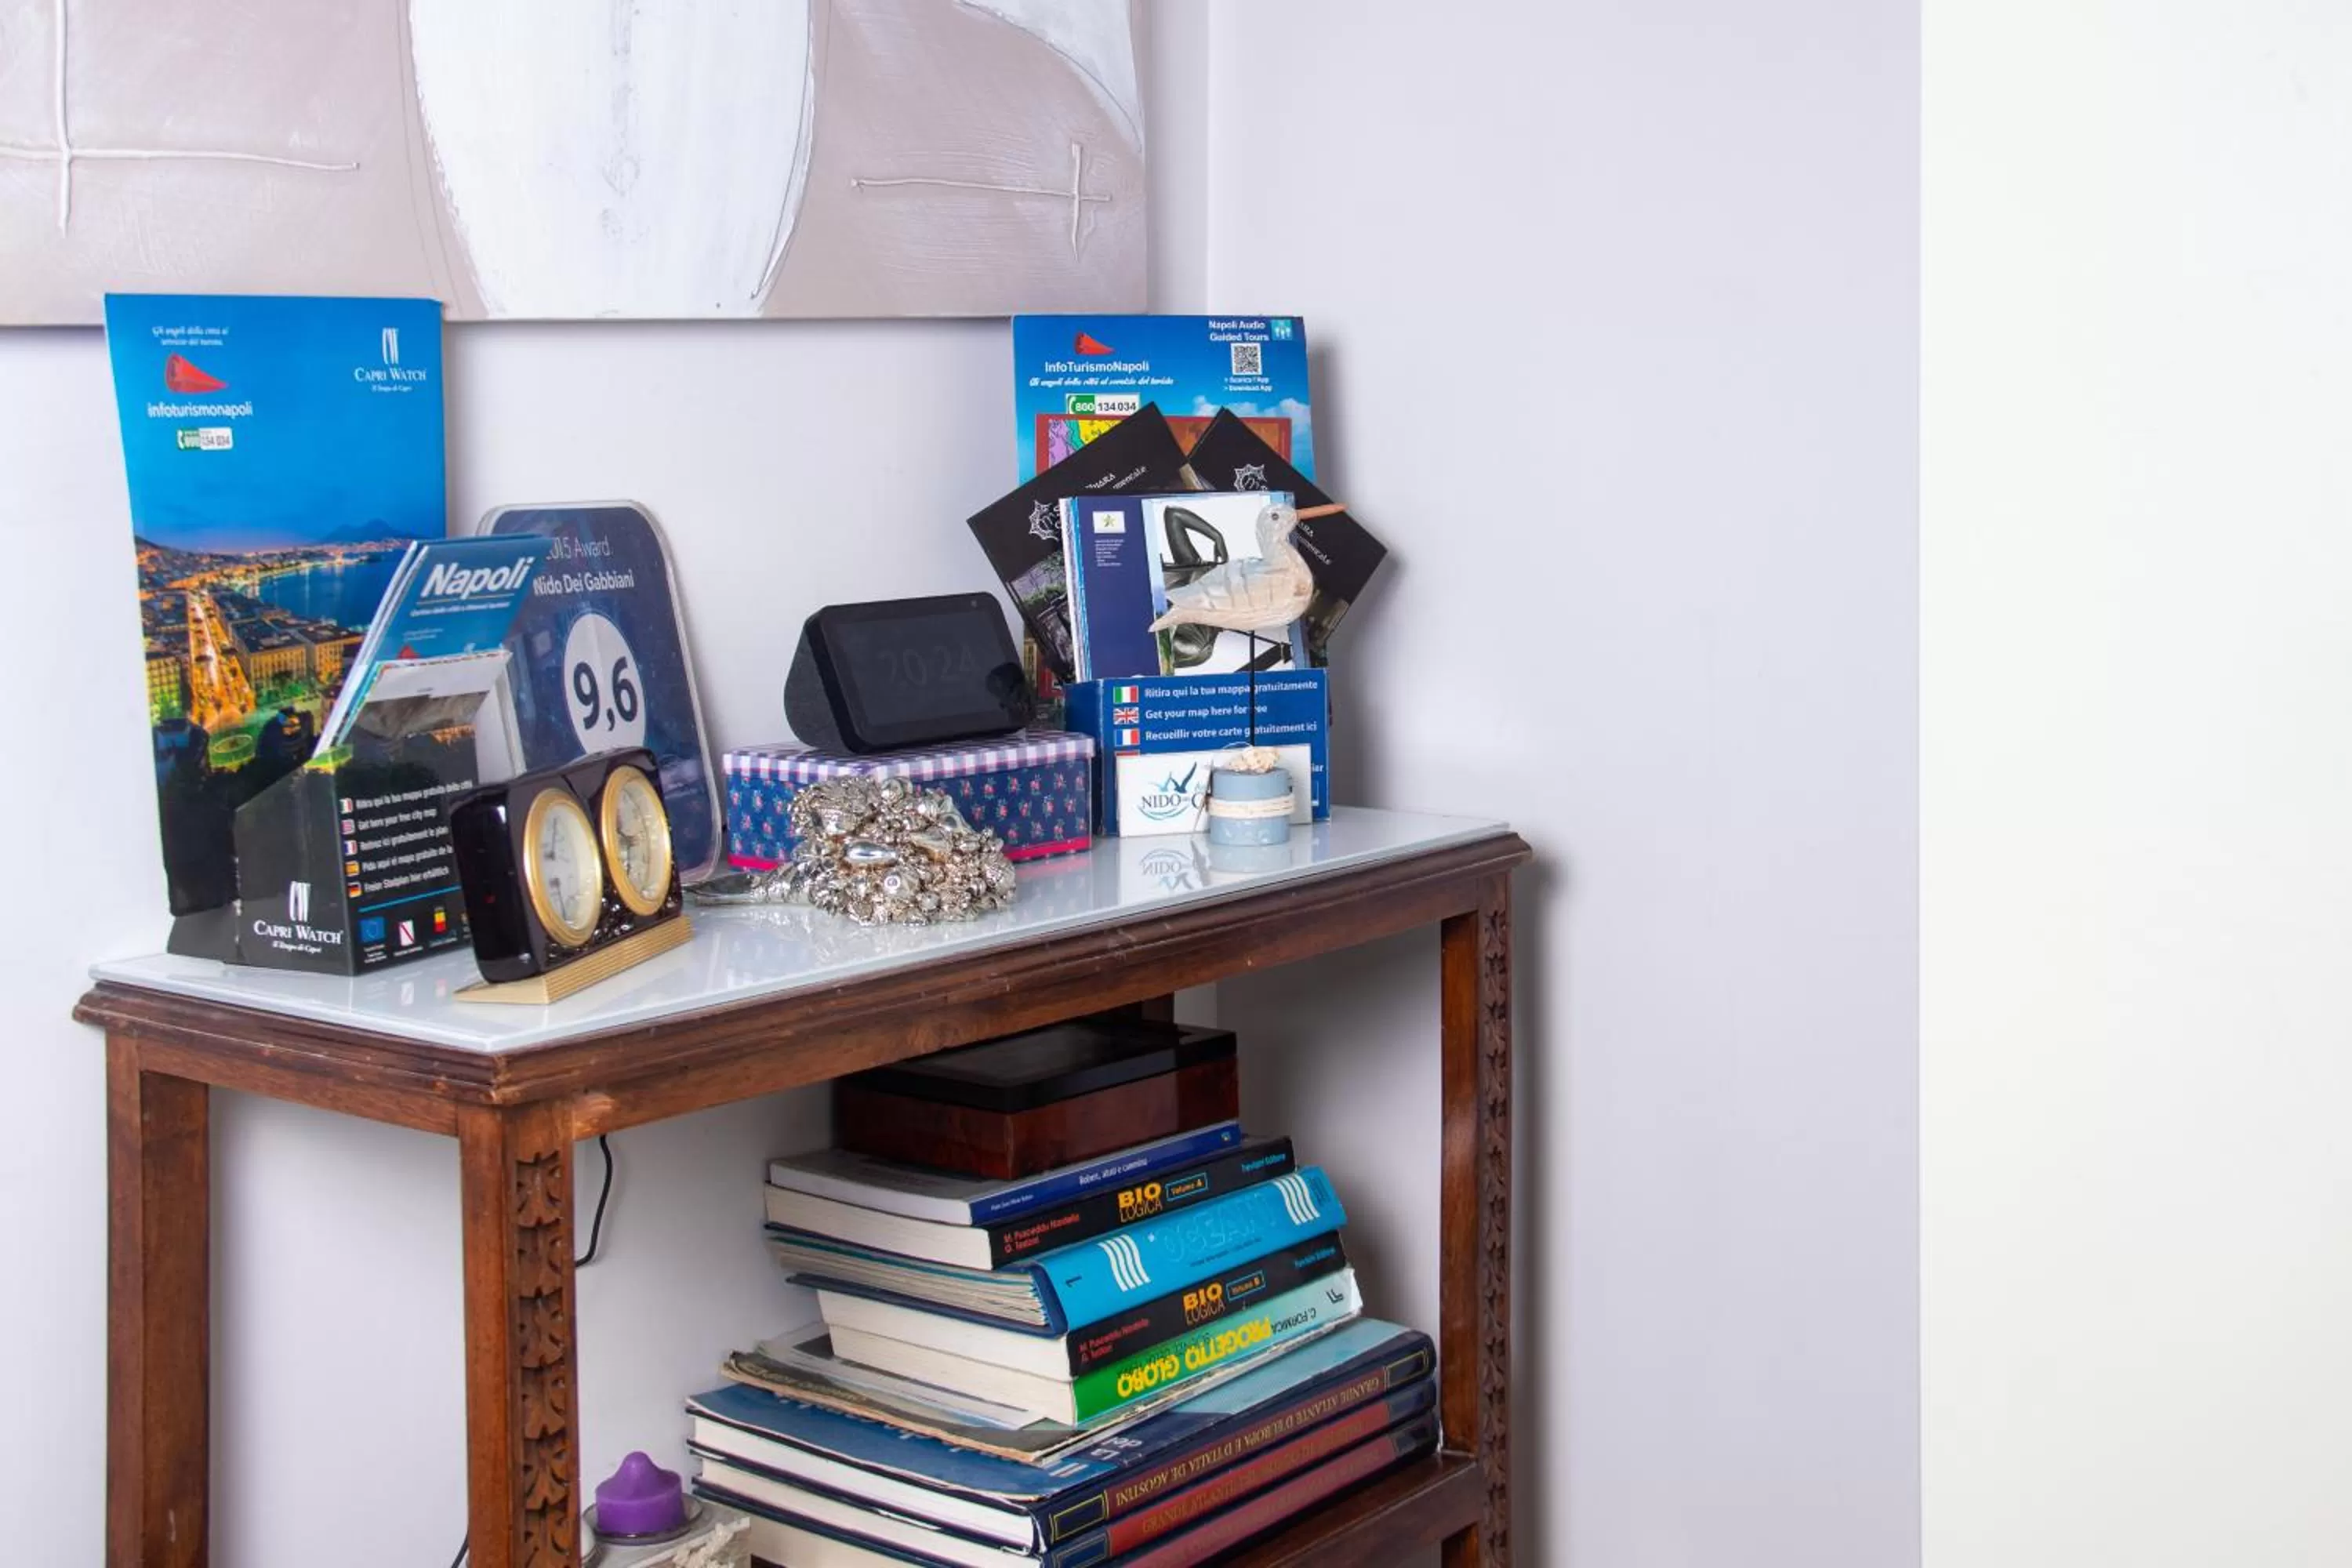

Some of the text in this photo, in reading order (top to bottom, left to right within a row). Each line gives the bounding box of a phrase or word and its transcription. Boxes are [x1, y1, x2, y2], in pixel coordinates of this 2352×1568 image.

[1208, 320, 1265, 331] Napoli Audio
[1210, 332, 1242, 341] Guided
[354, 367, 426, 382] CAPRI WATCH
[1045, 361, 1149, 373] InfoTurismoNapoli
[148, 401, 252, 419] infoturismonapoli
[1076, 402, 1136, 412] 800 134 034
[546, 534, 610, 560] 015 Award
[419, 556, 535, 600] Napoli
[533, 569, 634, 596] Nido Dei Gabbiani
[574, 655, 637, 731] 9,6
[1145, 687, 1171, 698] Ritira
[1172, 687, 1188, 699] qui
[1190, 685, 1199, 695] la
[1200, 687, 1215, 695] tua
[1218, 685, 1250, 696] mappa
[1145, 710, 1163, 719] Get
[1165, 709, 1185, 720] your
[1188, 707, 1210, 719] map
[1210, 706, 1232, 715] here
[1233, 705, 1248, 714] for
[1145, 720, 1318, 740] Recueillir votre carte gatuitement ici
[1142, 794, 1181, 809] NIDO
[253, 919, 342, 945] CAPRI WATCH
[1118, 1182, 1161, 1208] BIO
[1120, 1197, 1163, 1222] LOGICA
[1183, 1282, 1223, 1310] BIO
[1186, 1298, 1226, 1327] LOGICA
[1185, 1317, 1273, 1371] PROGETTO
[1117, 1354, 1180, 1398] GLOBO
[1340, 1377, 1379, 1405] GRANDE
[1296, 1395, 1338, 1425] ATLANTE
[1171, 1462, 1187, 1479] DE
[1116, 1469, 1169, 1506] AGOSTINI
